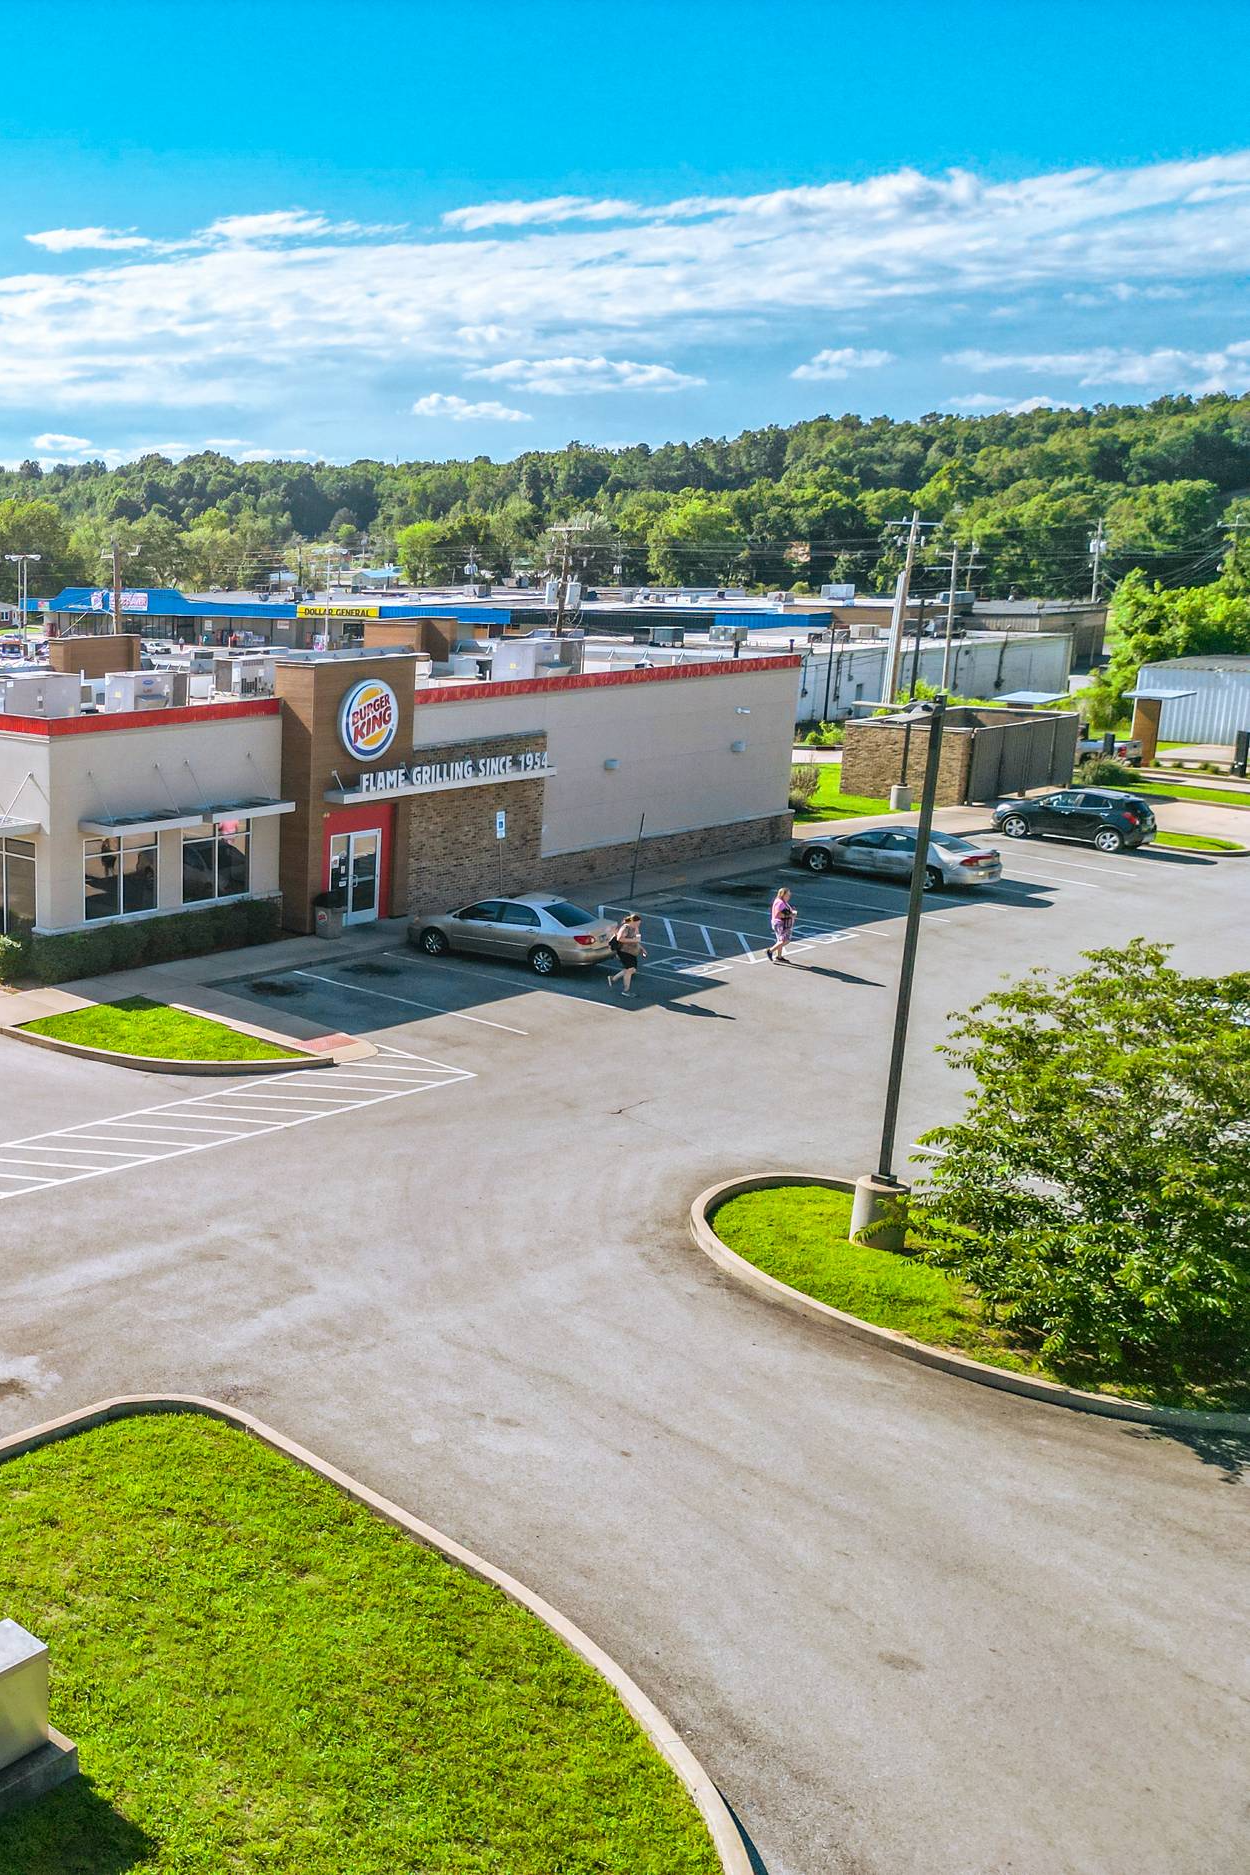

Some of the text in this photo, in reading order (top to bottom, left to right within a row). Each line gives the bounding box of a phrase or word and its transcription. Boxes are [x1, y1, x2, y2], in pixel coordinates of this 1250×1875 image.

[304, 607, 371, 617] DOLLAR GENERAL
[352, 694, 391, 727] BURGER
[353, 706, 392, 744] KING
[360, 751, 548, 793] FLAME GRILLING SINCE 1954
